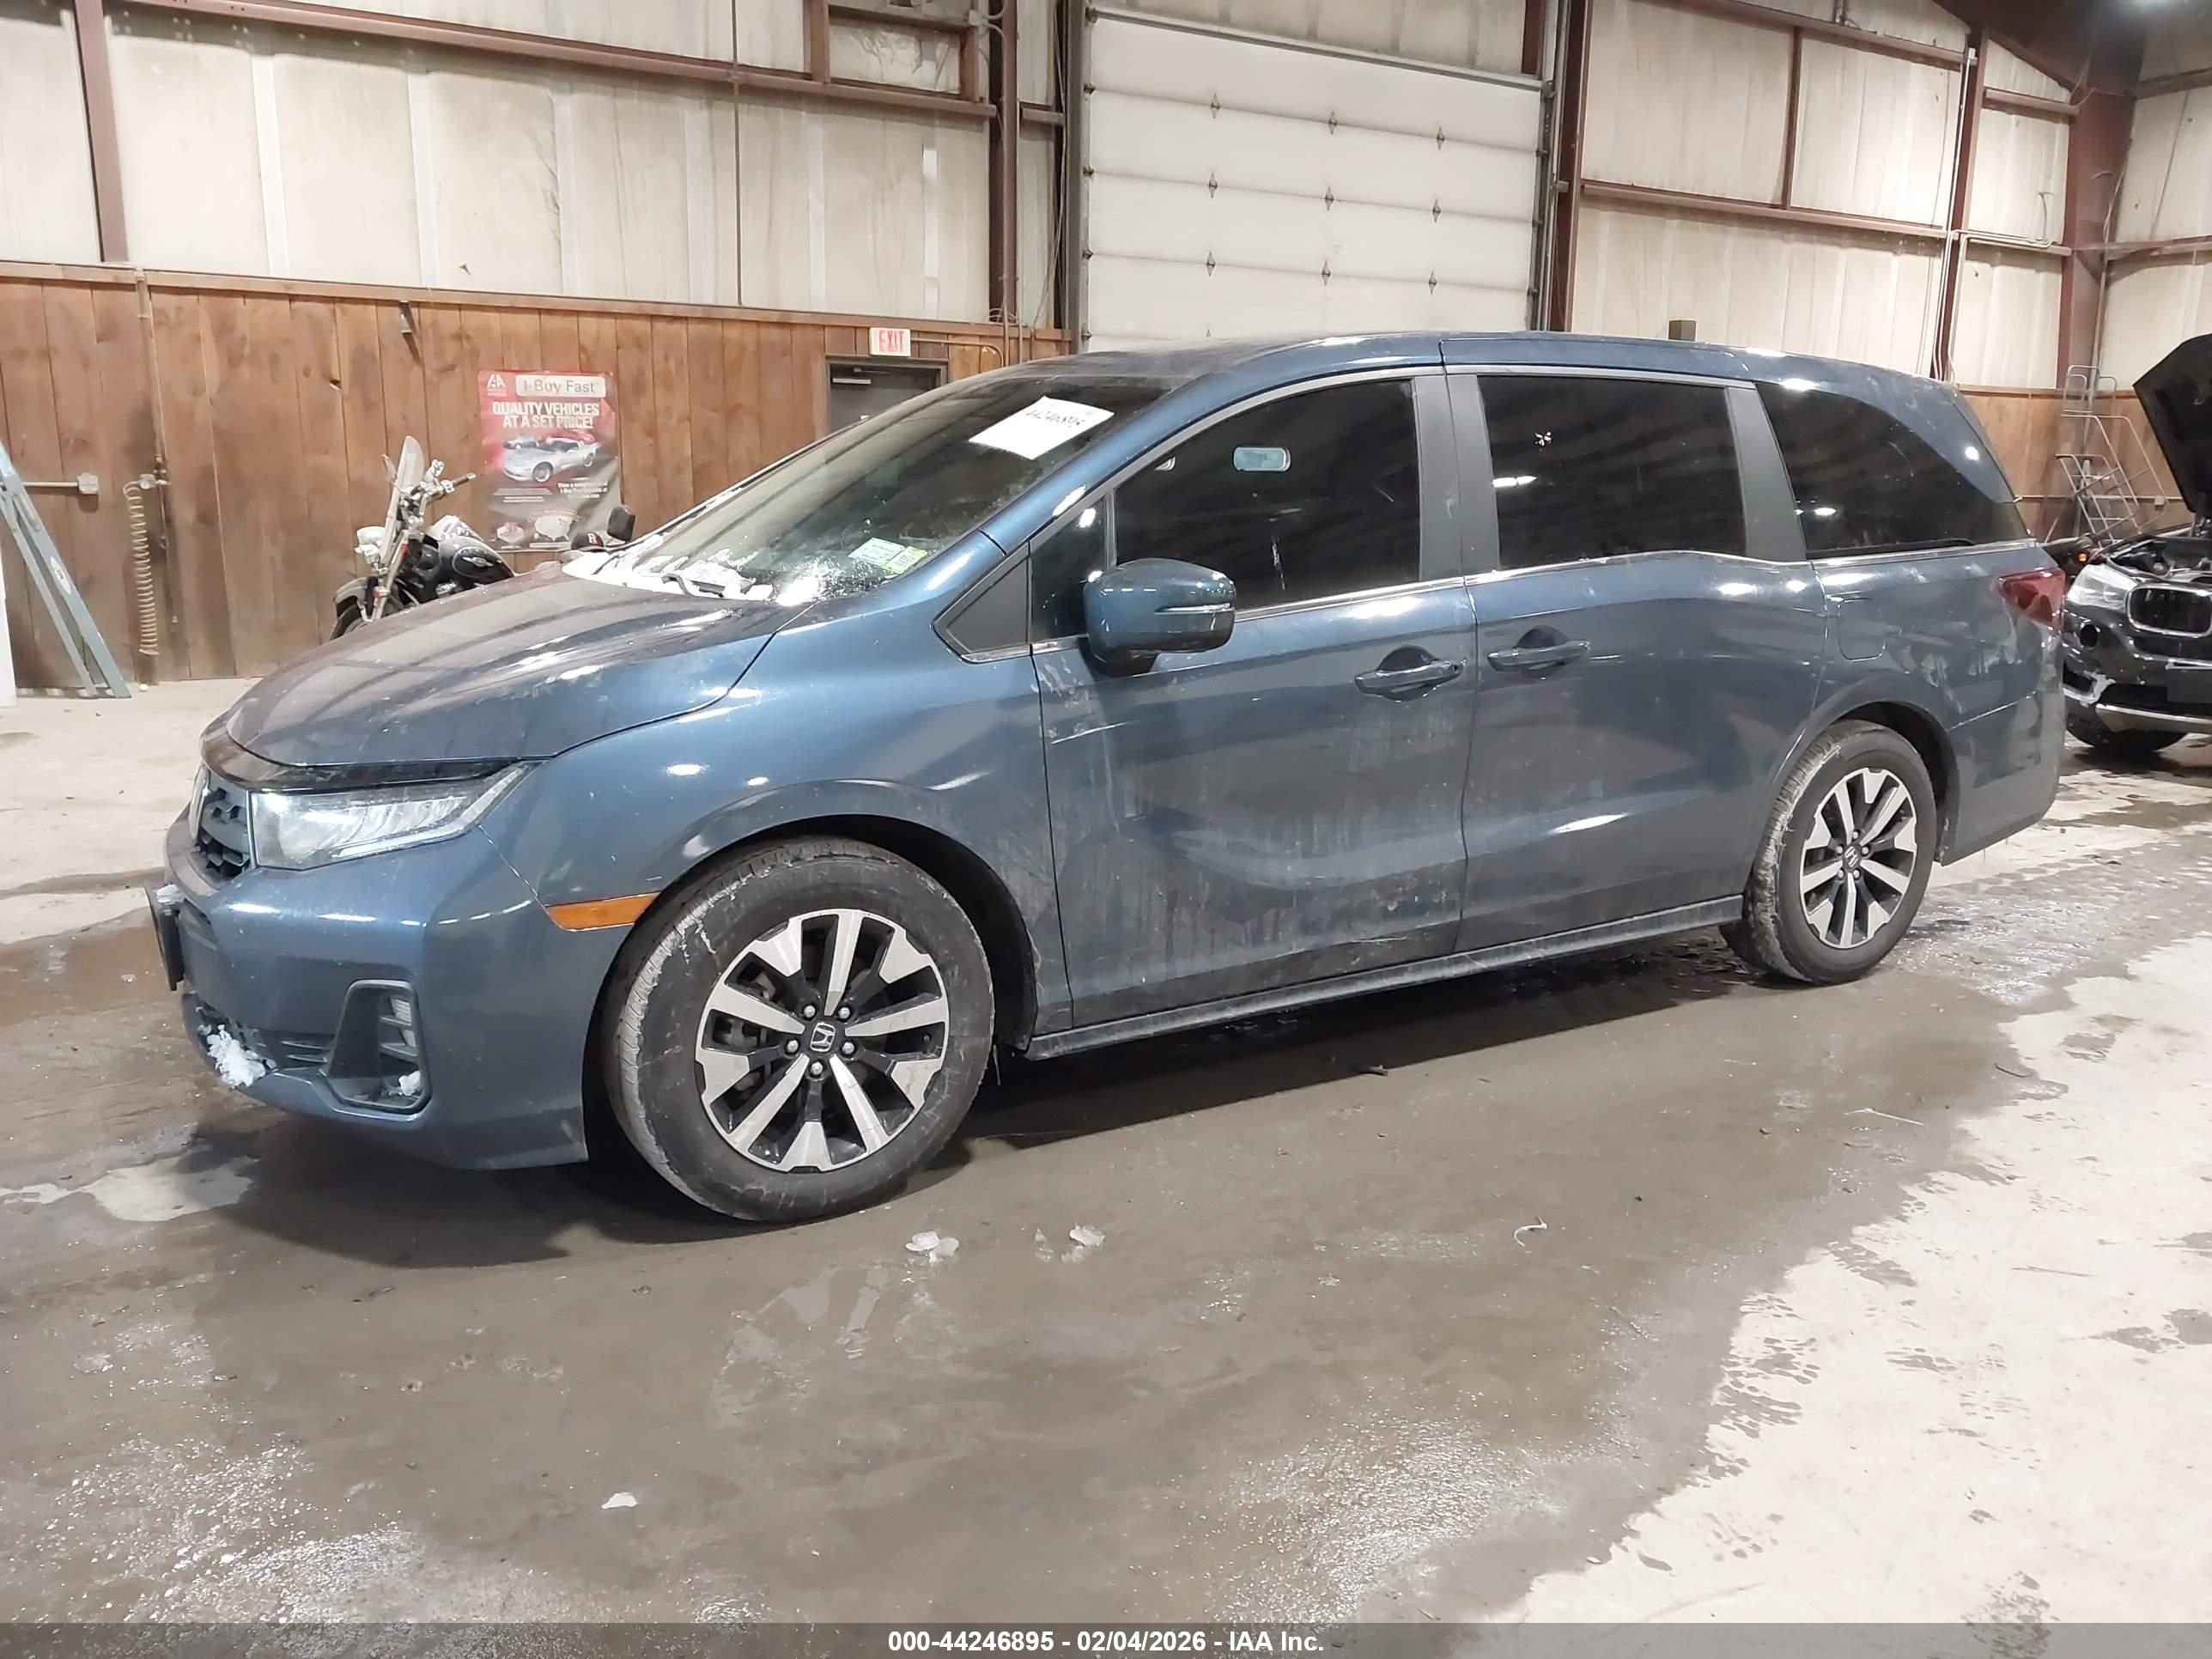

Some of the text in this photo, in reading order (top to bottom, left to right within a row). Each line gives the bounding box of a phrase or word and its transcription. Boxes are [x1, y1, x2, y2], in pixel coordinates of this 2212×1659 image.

[878, 330, 905, 352] EXIT
[524, 380, 562, 394] I-Buy
[566, 380, 595, 393] Fast
[492, 401, 599, 416] QUALITY VEHICLES
[503, 415, 594, 428] AT A SET PRICE!
